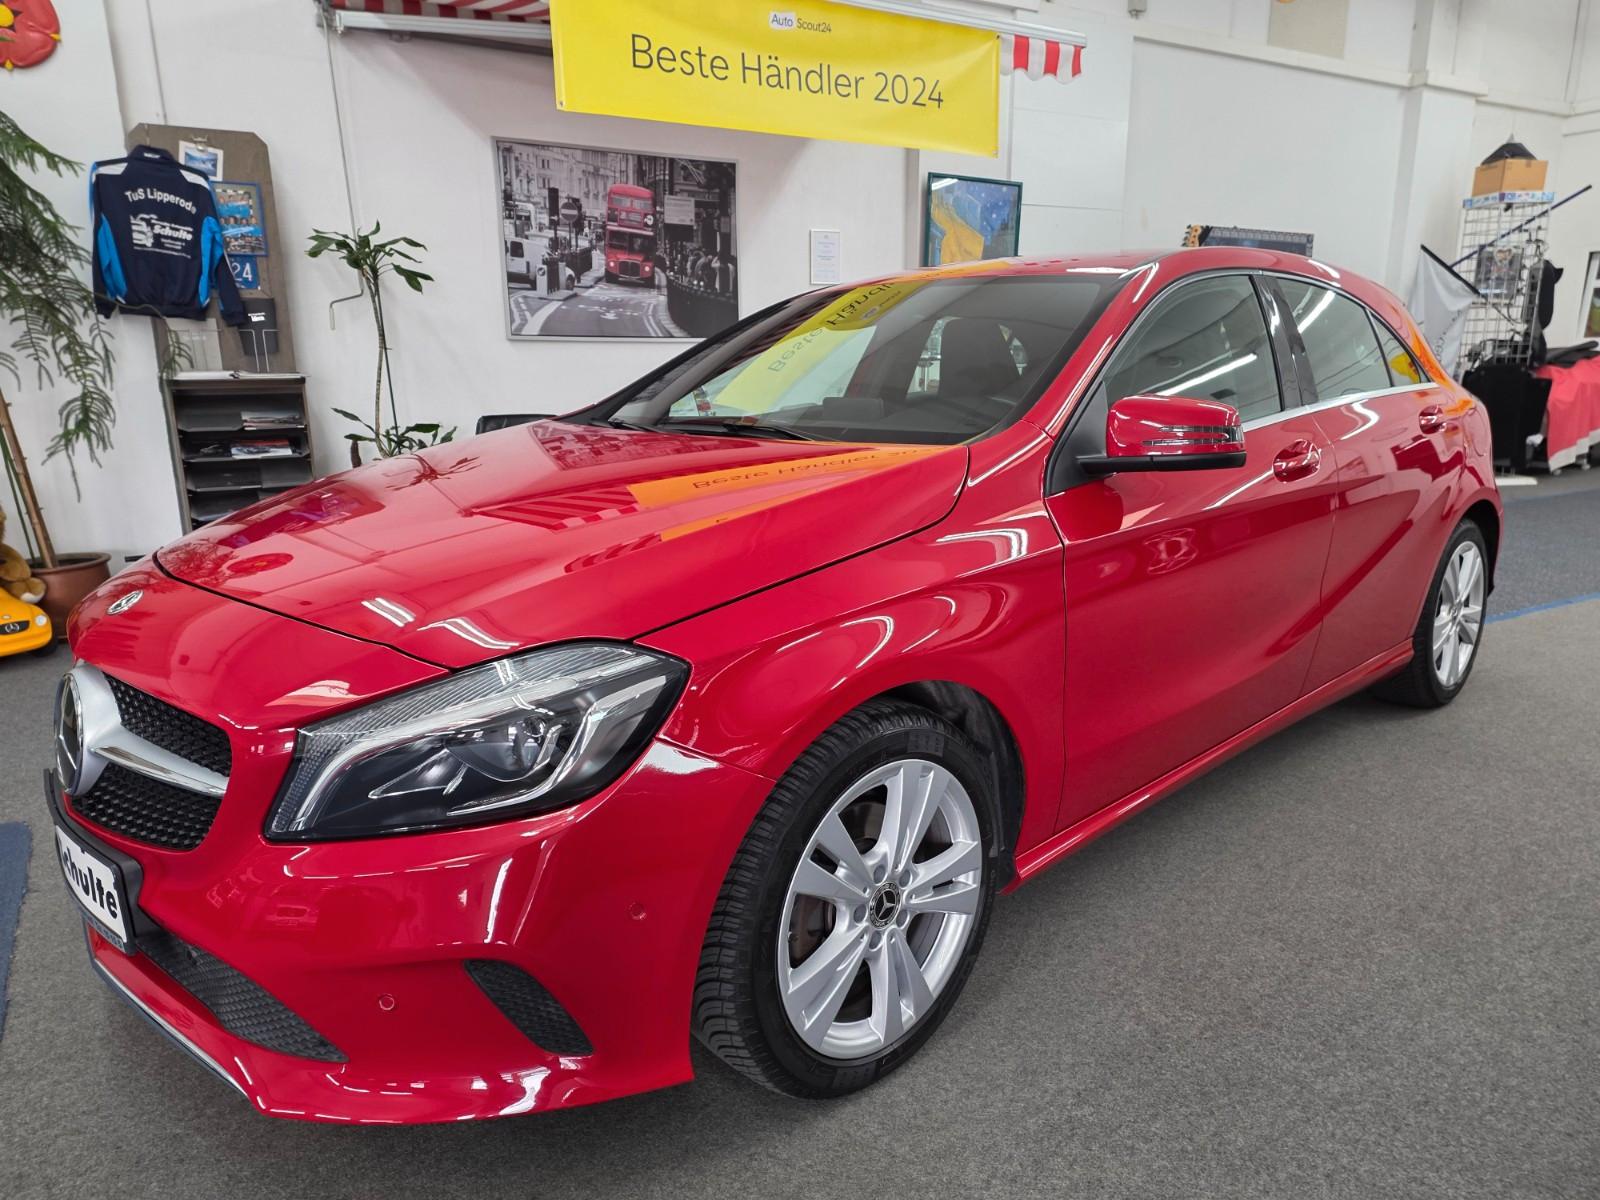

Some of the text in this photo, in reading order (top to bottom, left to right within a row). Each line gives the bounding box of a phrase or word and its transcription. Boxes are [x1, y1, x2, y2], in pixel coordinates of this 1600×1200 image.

[771, 13, 832, 33] Auto Scout24
[630, 33, 944, 109] Beste Händler 2024
[124, 188, 145, 202] TuS
[60, 842, 118, 919] chulte
